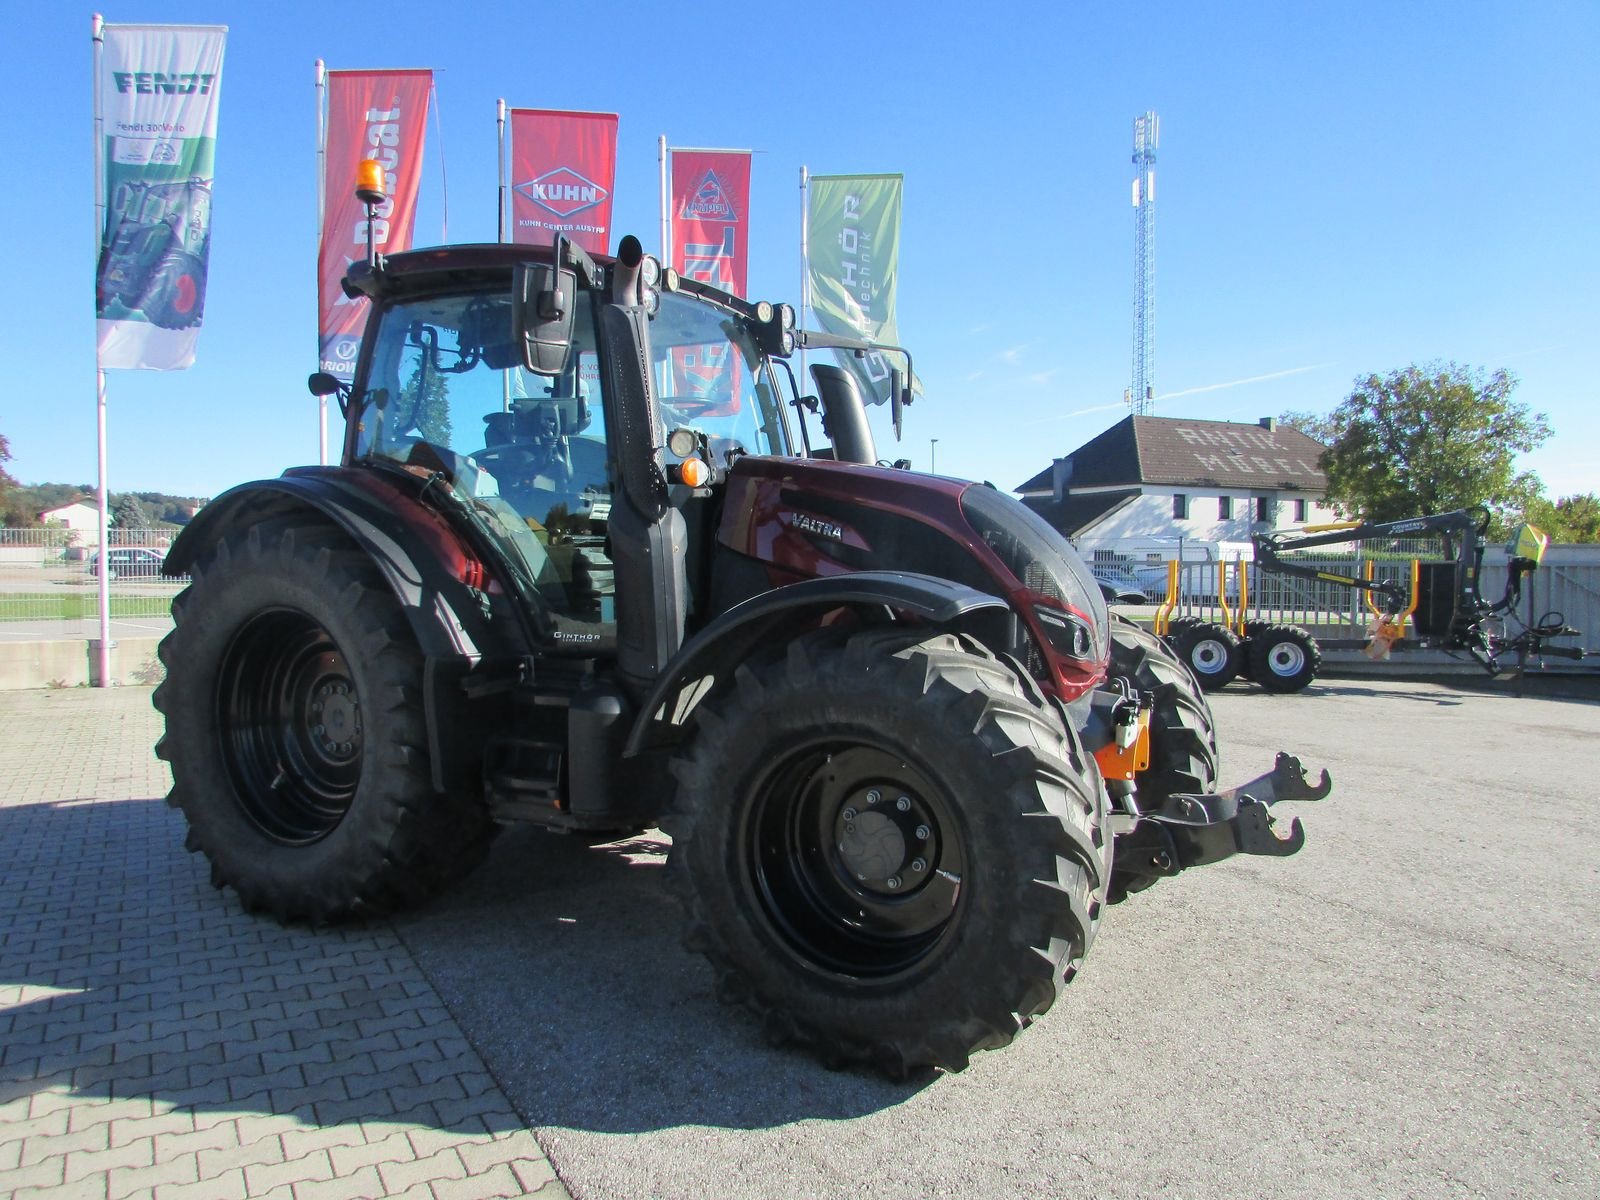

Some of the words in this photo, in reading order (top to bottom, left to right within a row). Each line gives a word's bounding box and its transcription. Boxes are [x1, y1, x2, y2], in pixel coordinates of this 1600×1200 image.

[113, 72, 215, 95] FENDT
[532, 184, 596, 201] KUHN
[520, 219, 541, 227] KUHN
[543, 222, 574, 231] CENTER
[792, 512, 842, 540] VALTRA
